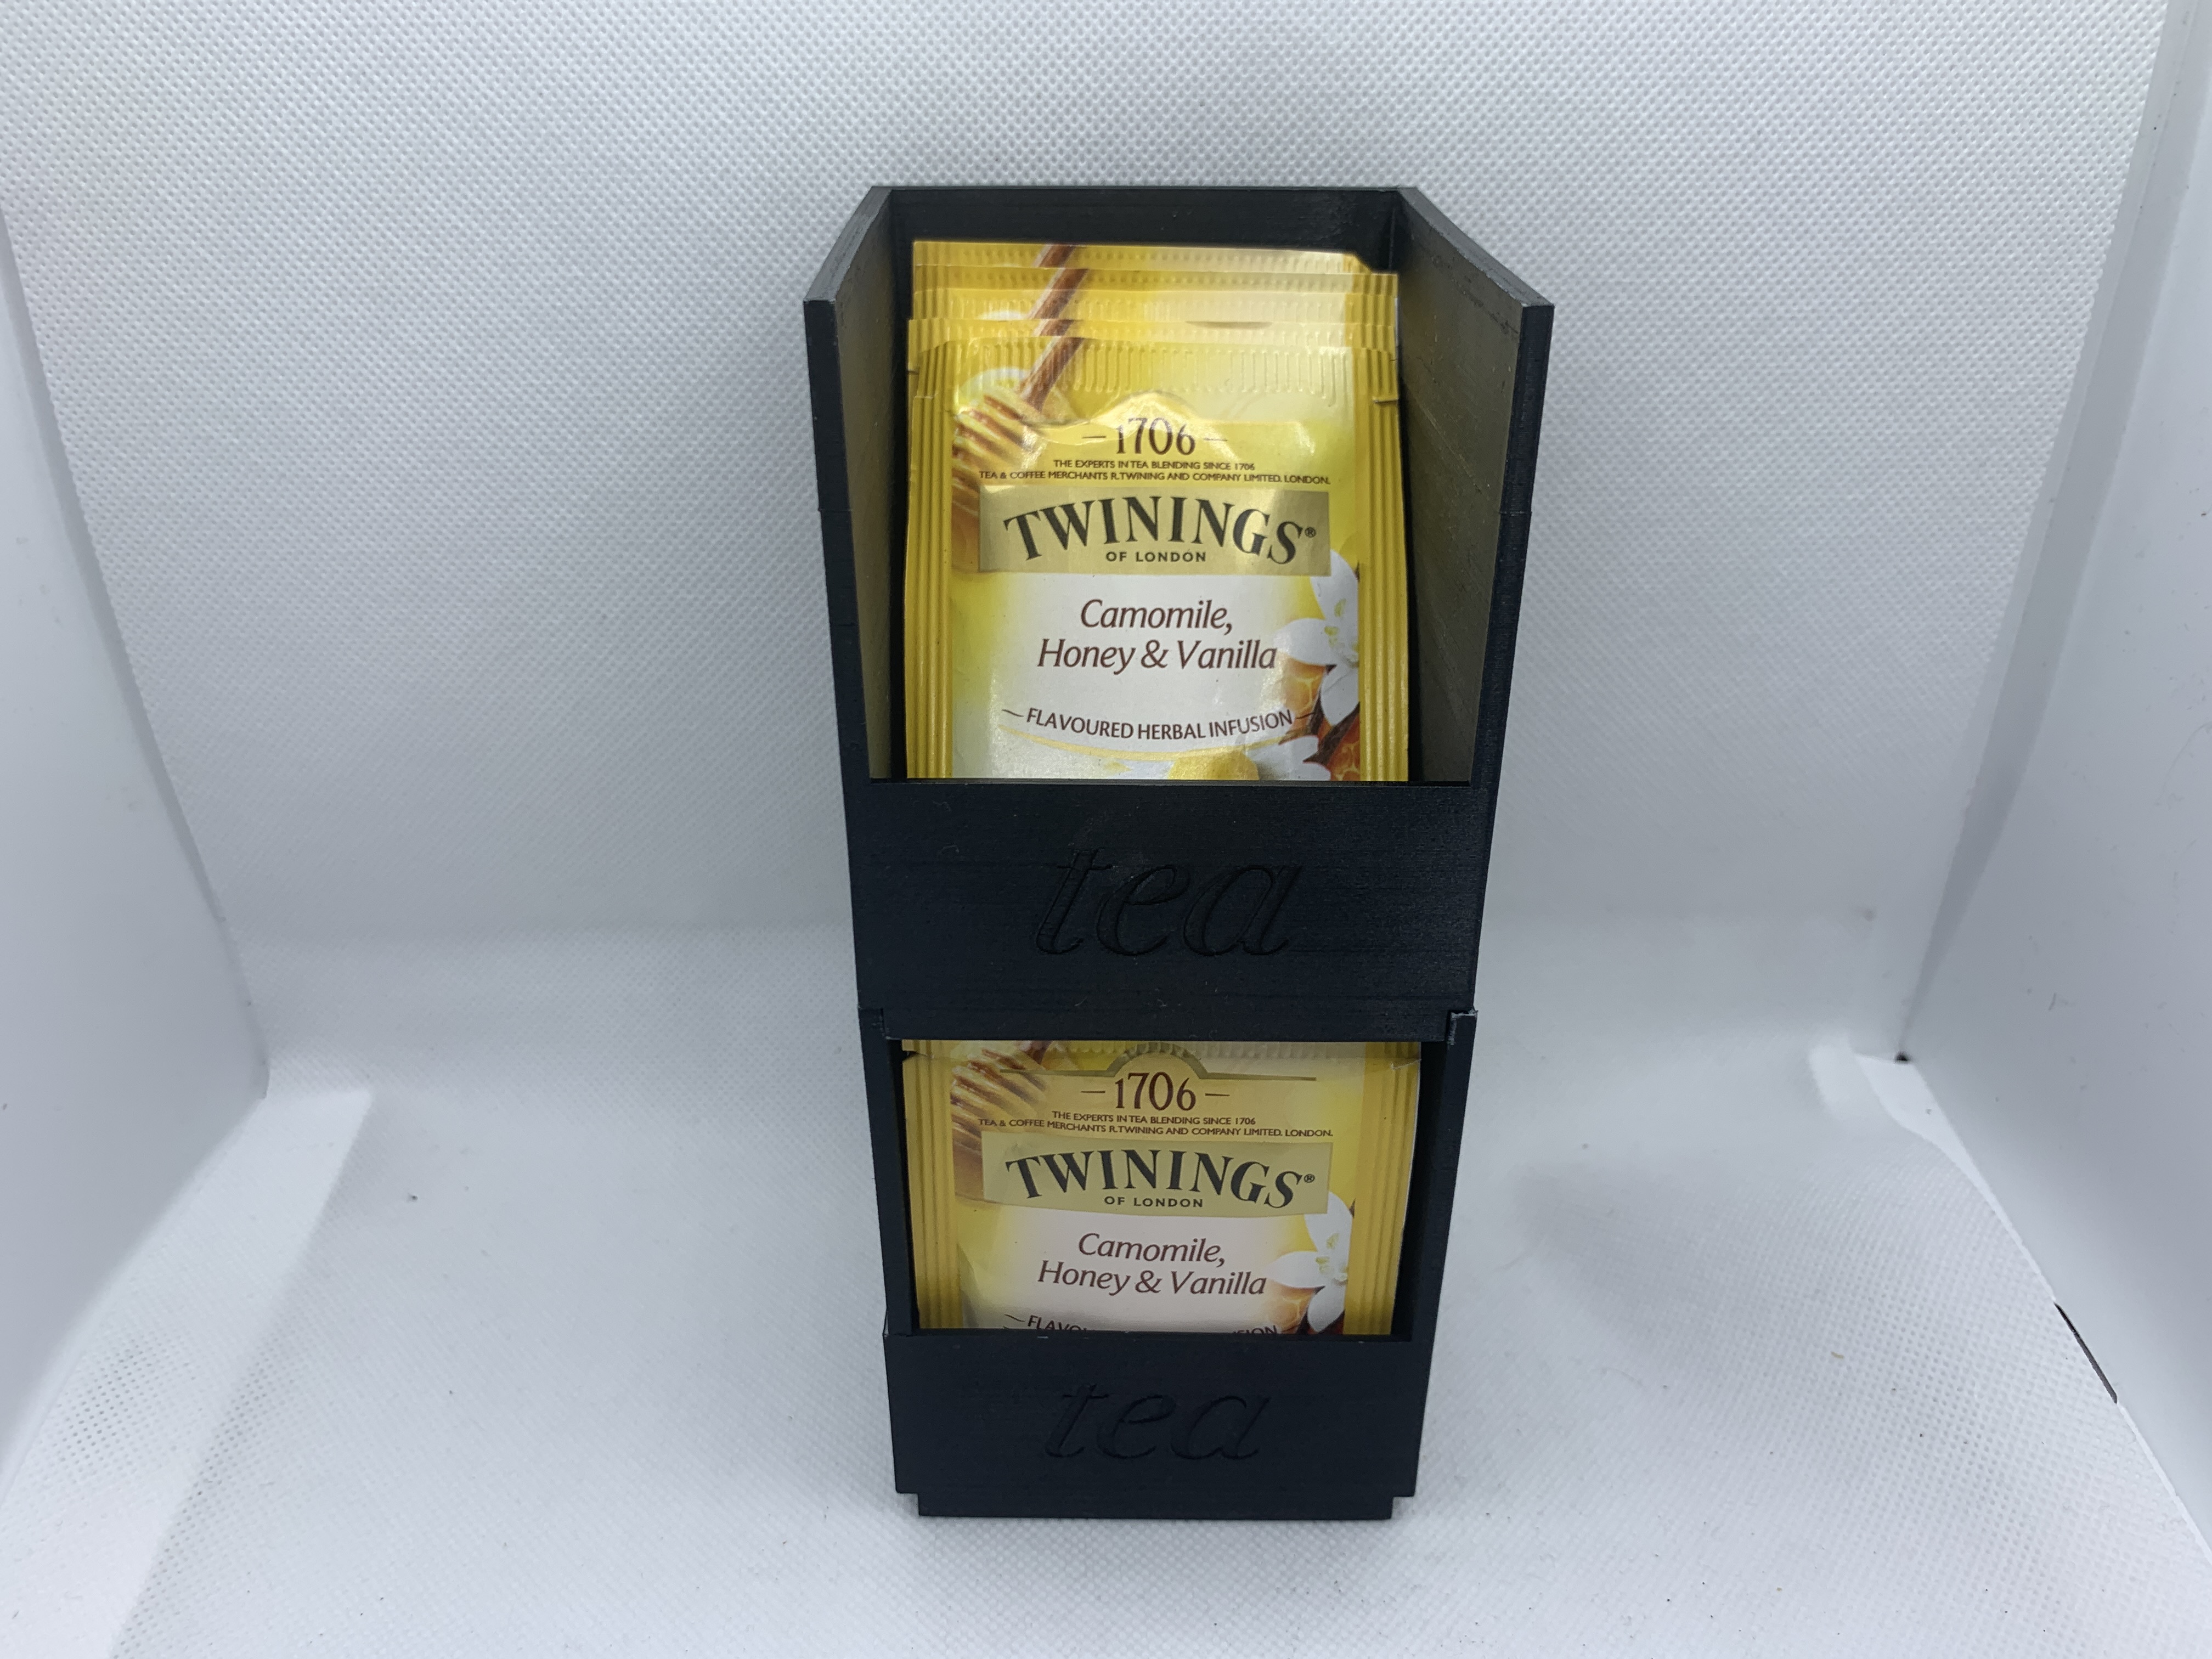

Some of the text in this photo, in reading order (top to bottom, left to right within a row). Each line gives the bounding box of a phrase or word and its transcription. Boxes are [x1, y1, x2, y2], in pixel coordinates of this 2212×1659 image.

[1115, 417, 1195, 455] 1706
[979, 471, 997, 479] TEA
[1048, 471, 1108, 480] MERCHANTS
[1193, 473, 1240, 482] COMPANY
[1075, 460, 1115, 469] EXPERTS
[1130, 461, 1148, 469] TEA
[1152, 461, 1200, 470] BLENDING
[1203, 462, 1231, 470] SINCE
[1106, 551, 1206, 562] OF LONDON
[1080, 599, 1233, 635] Camomile,
[1037, 639, 1277, 675] Honey & Vanilla
[1026, 708, 1293, 740] FLAVOURED HERBAL INFUSION
[1035, 849, 1302, 956] tea
[1115, 1071, 1197, 1111] 1706
[1009, 1119, 1045, 1127] COFFEE
[1047, 1120, 1105, 1132] MERCHANTS
[1192, 1127, 1241, 1136] COMPANY
[1052, 1111, 1071, 1120] THE
[1074, 1113, 1114, 1122] EXPERTS
[1128, 1115, 1147, 1124] TEA
[1150, 1116, 1200, 1125] BLENDING
[1235, 1117, 1256, 1125] 1706
[1104, 1196, 1203, 1208] OF LONDON
[1077, 1232, 1226, 1268] Camomile,
[1037, 1260, 1267, 1296] Honey & Vanilla
[1044, 1384, 1272, 1461] tea
